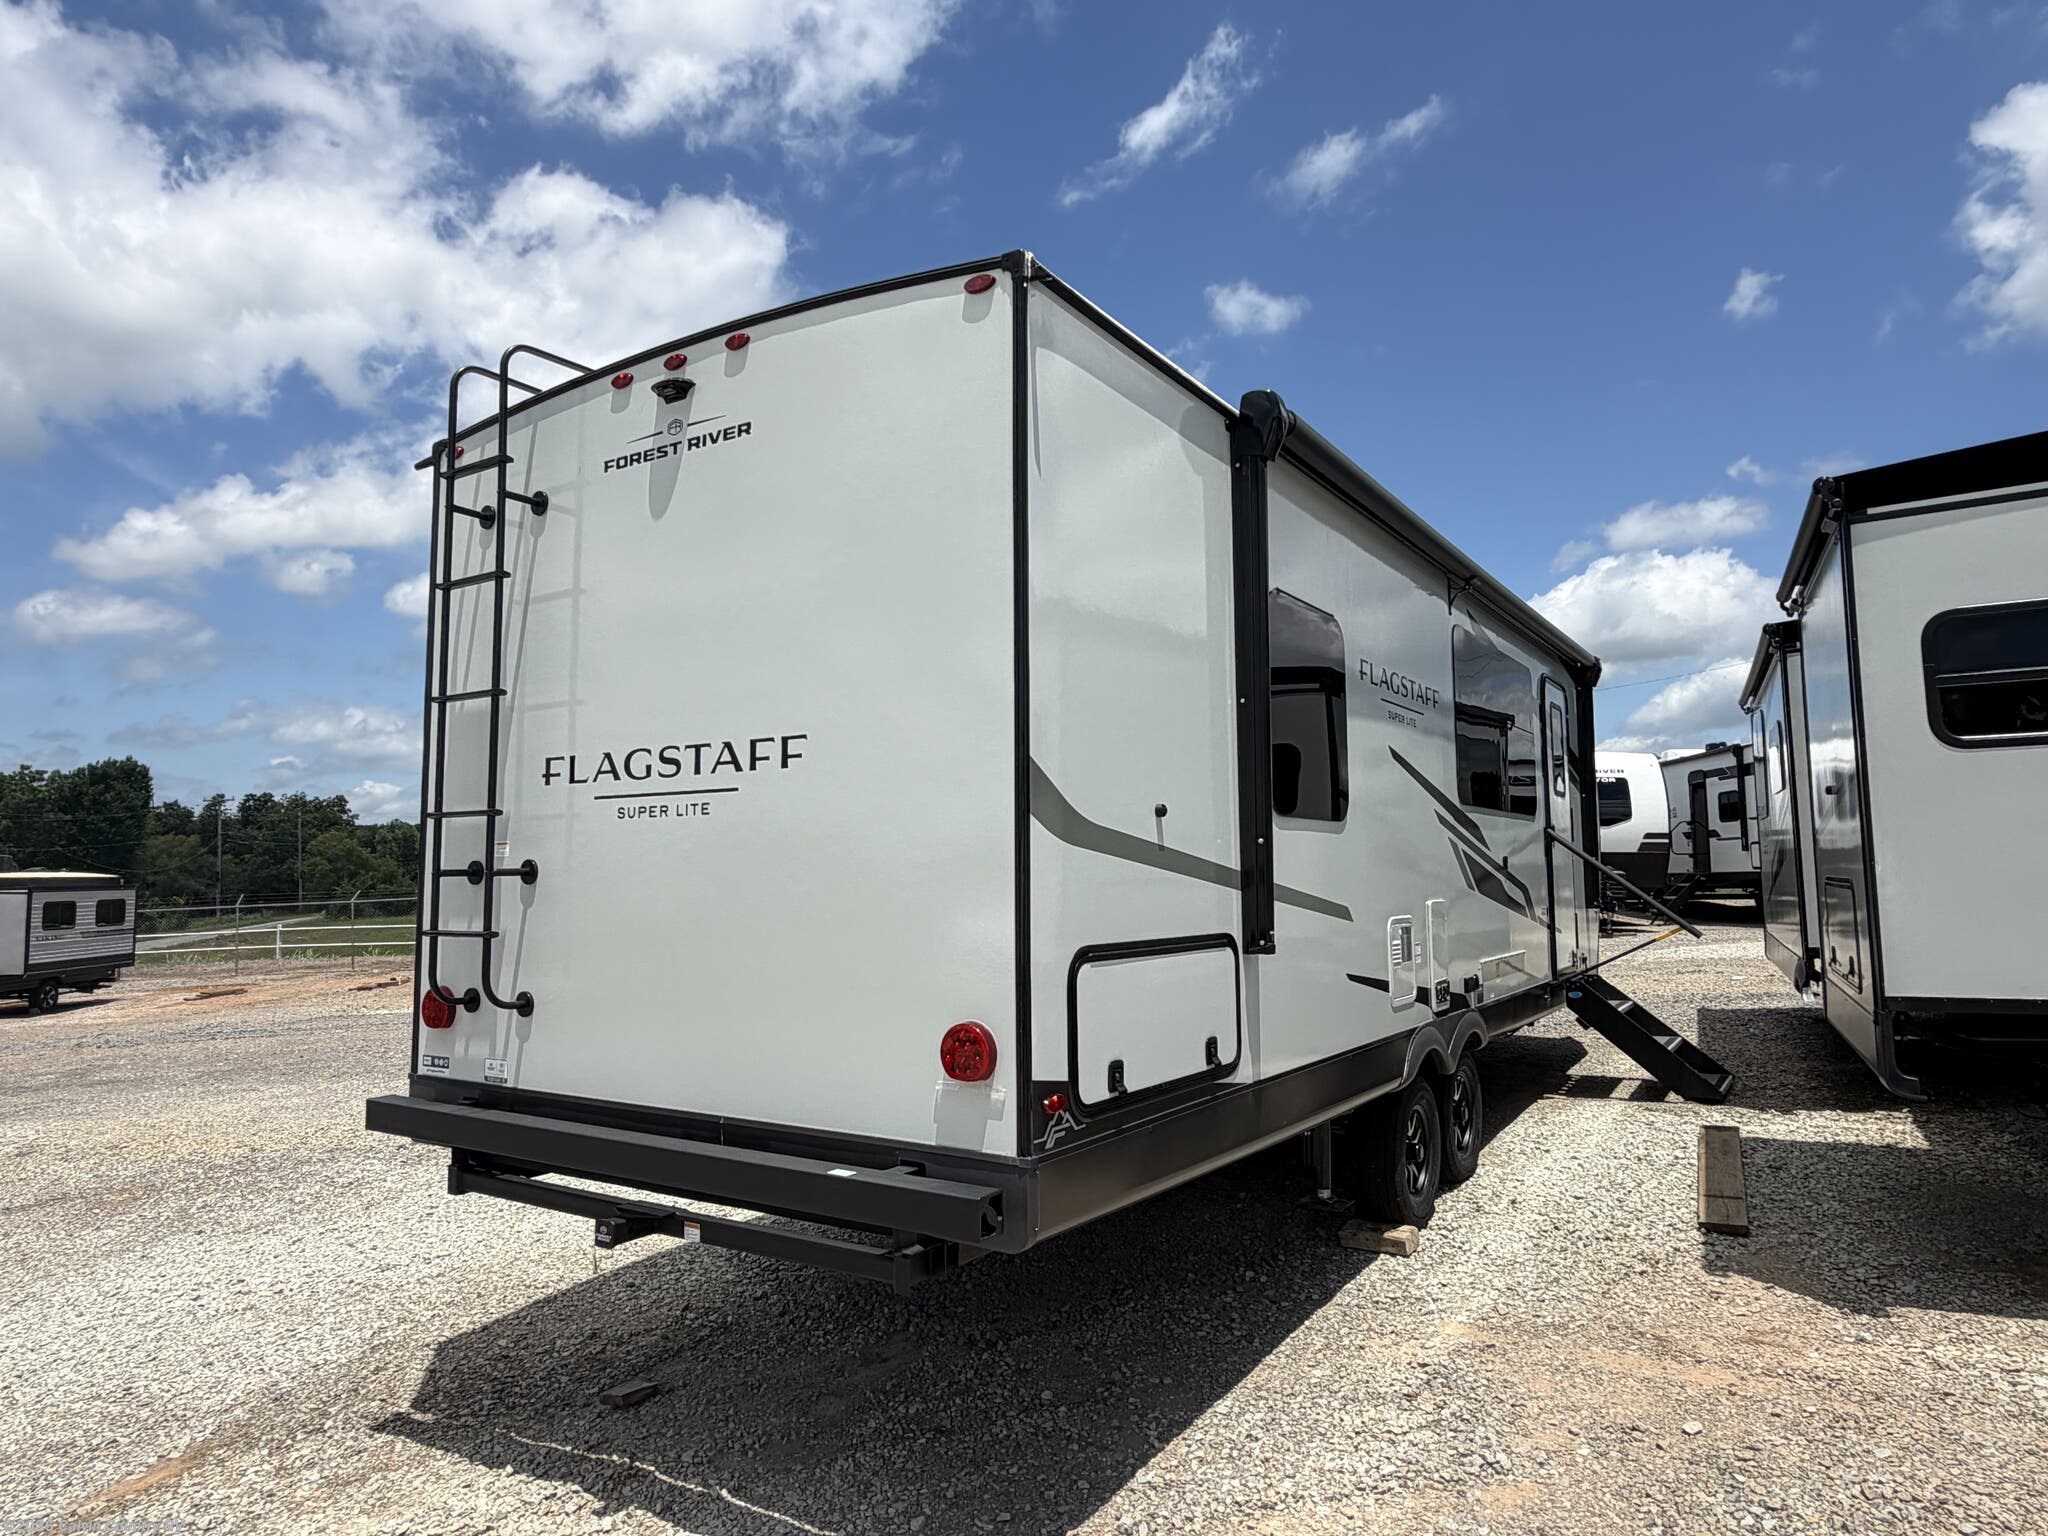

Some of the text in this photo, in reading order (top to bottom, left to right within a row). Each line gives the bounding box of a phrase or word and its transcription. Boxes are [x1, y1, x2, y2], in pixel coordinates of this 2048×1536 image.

[603, 421, 752, 473] FOREST RIVER
[1358, 657, 1440, 709] FLAGSTAFF
[541, 734, 808, 786] FLAGSTAFF
[616, 802, 712, 820] SUPER LITE
